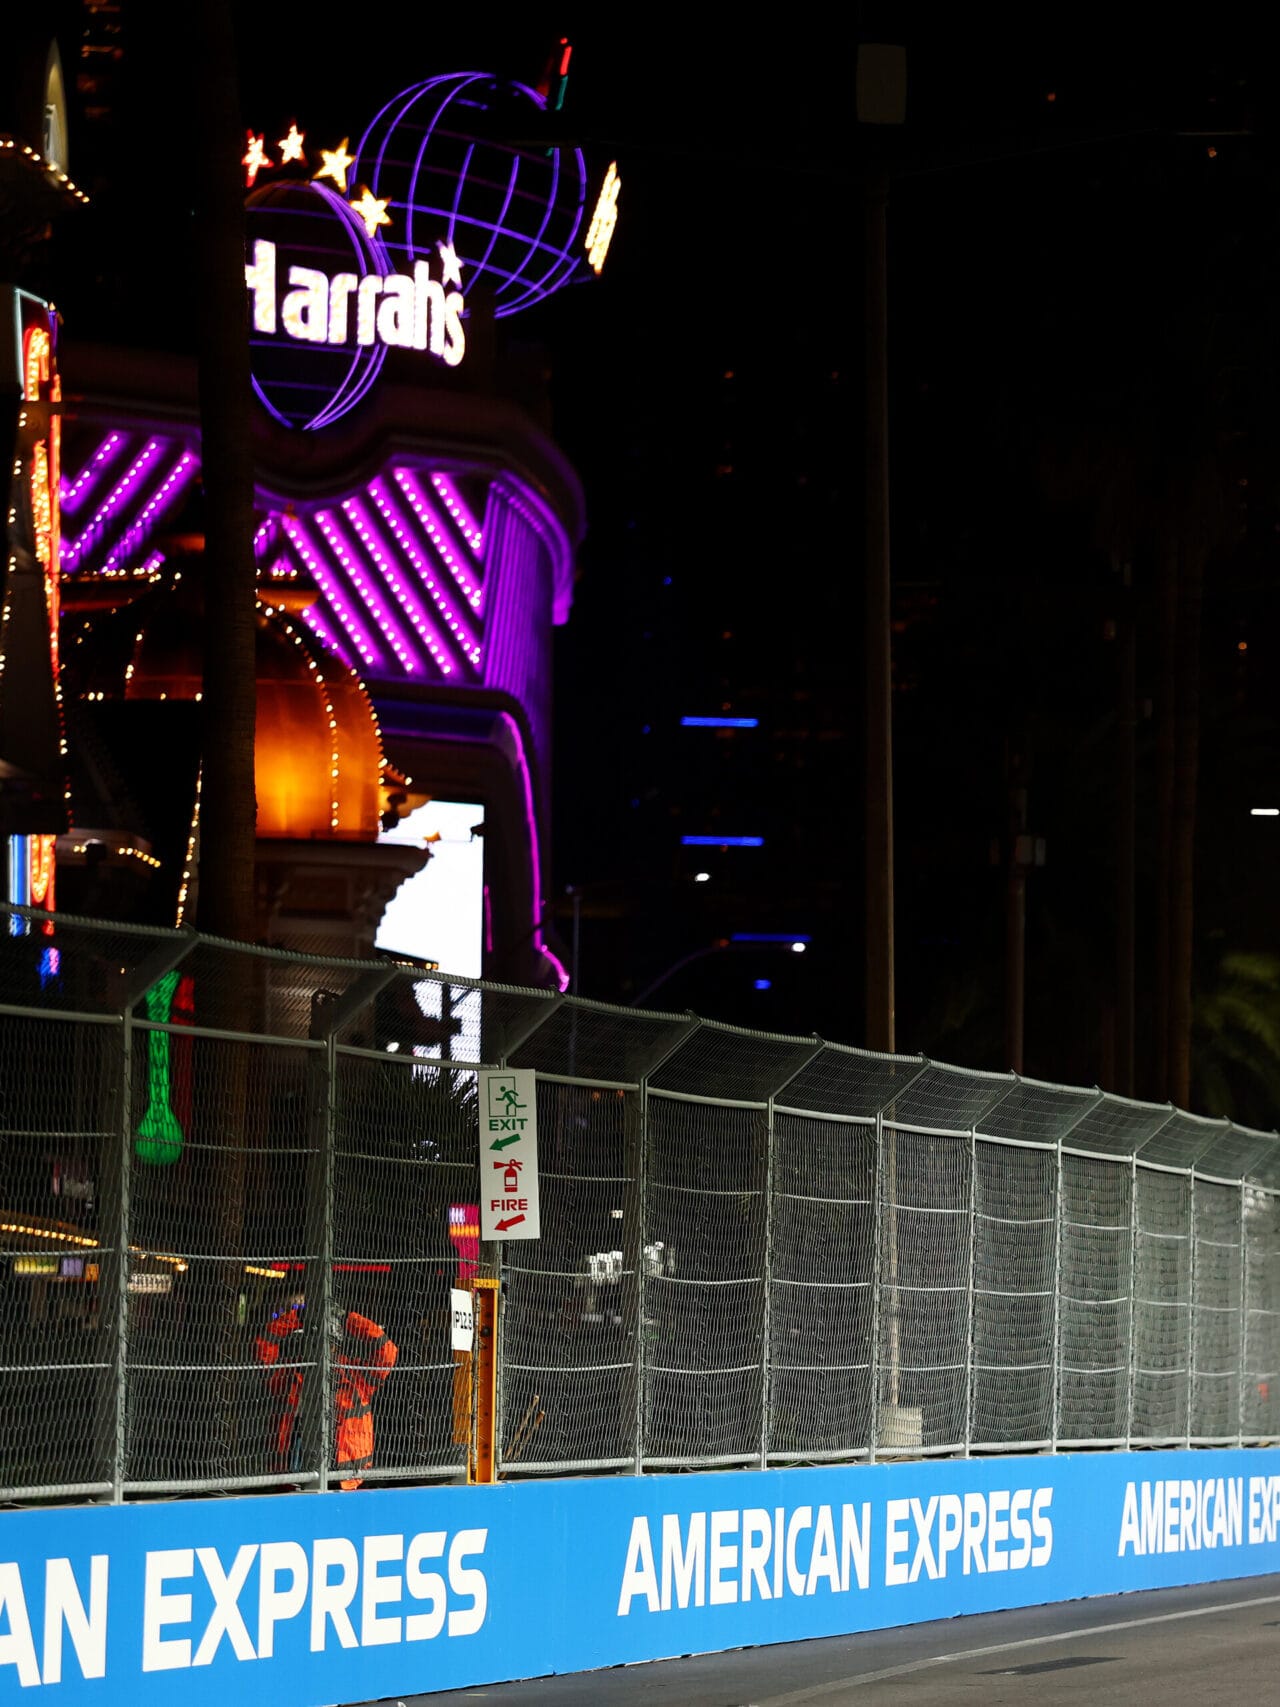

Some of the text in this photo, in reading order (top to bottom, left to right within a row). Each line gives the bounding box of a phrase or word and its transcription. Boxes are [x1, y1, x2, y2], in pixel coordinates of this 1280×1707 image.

[489, 1118, 528, 1131] EXIT
[490, 1198, 528, 1212] FIRE
[617, 1487, 1054, 1617] AMERICAN EXPRESS
[1118, 1476, 1244, 1557] AMERICAN
[142, 1528, 488, 1673] EXPRESS
